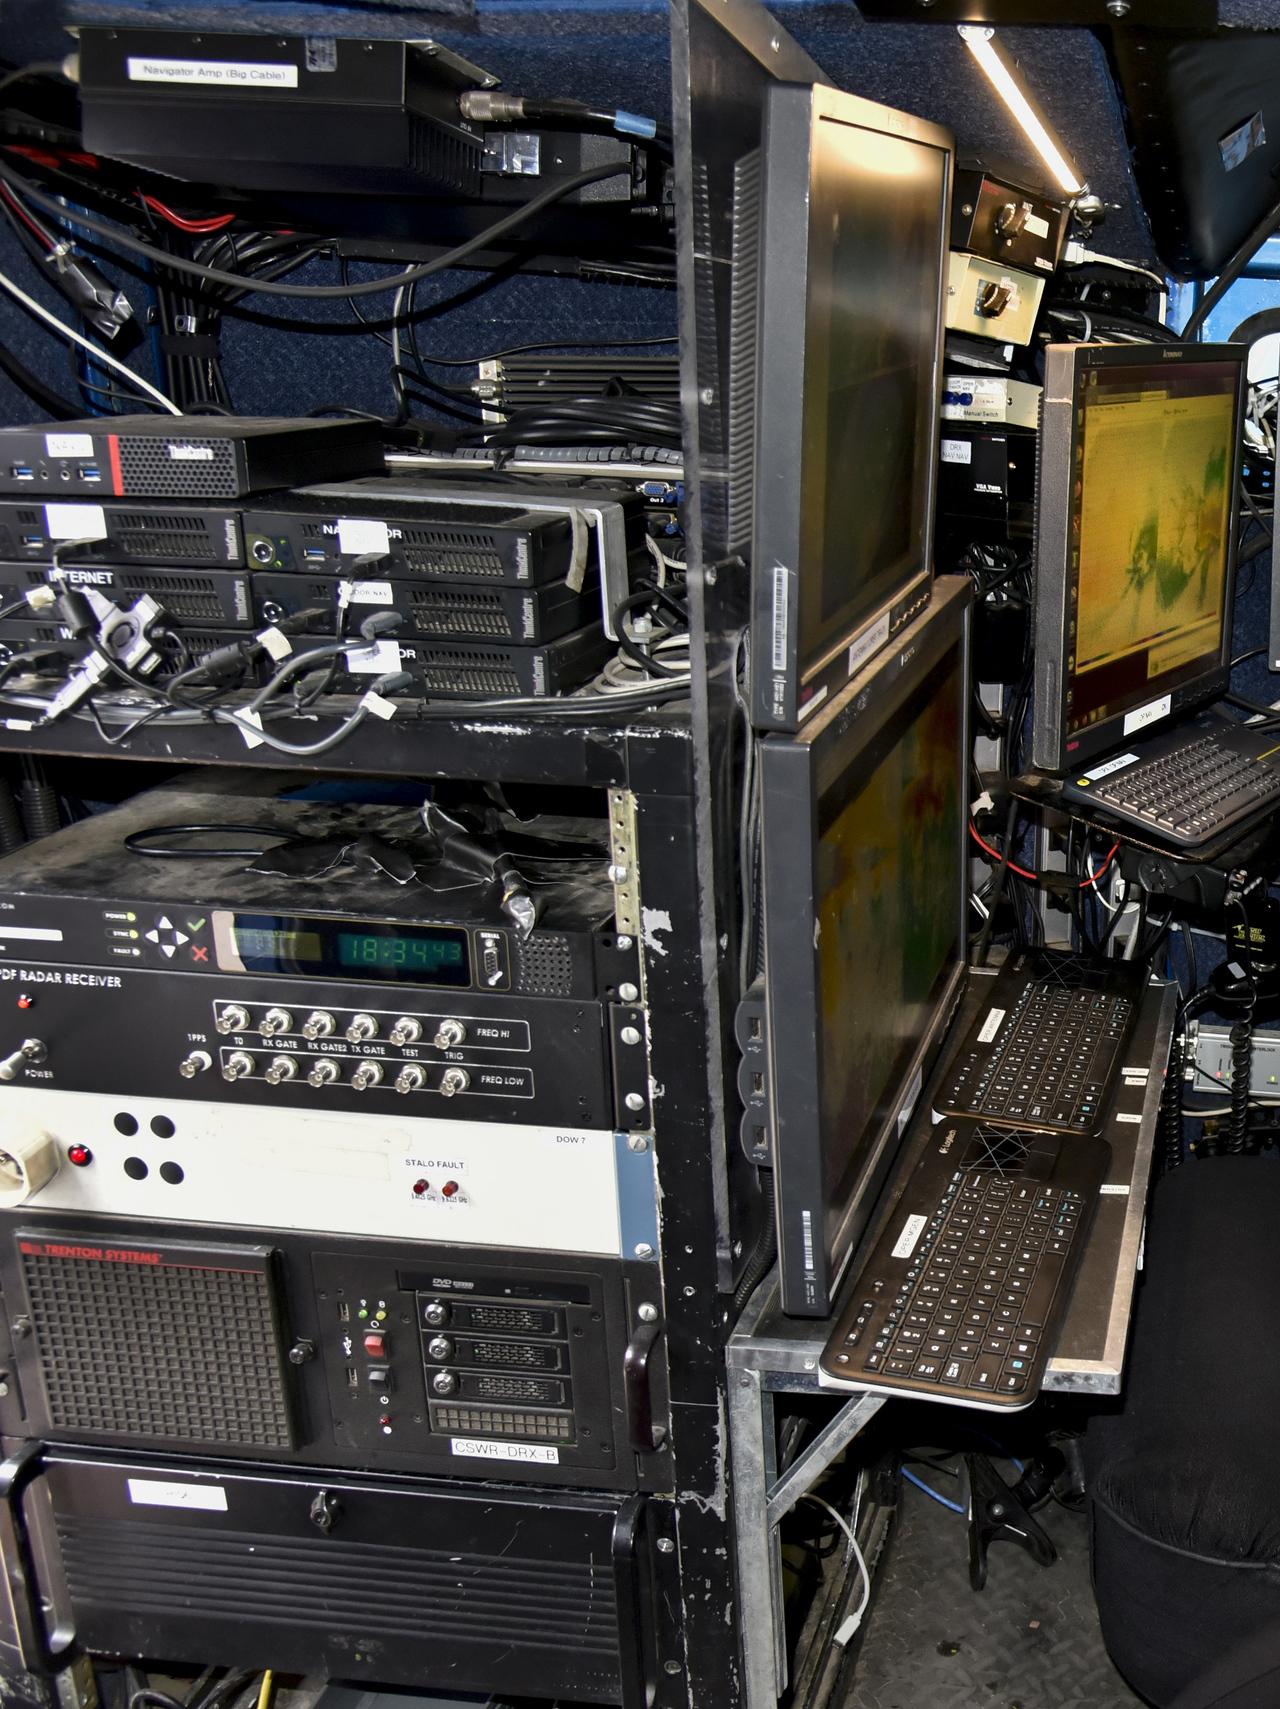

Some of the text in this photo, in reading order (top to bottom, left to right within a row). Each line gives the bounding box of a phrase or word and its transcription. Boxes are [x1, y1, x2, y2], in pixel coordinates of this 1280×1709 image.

[143, 64, 286, 81] Navigator Amp (Big Cable)
[224, 519, 239, 561] ThinkCentre
[516, 538, 528, 579] ThinkCentre
[234, 580, 249, 621] ThinkCentre
[523, 598, 534, 639] ThinkCentre
[533, 656, 545, 696] ThinkCentre
[352, 938, 427, 964] 18:34
[20, 970, 62, 984] RADAR
[65, 972, 122, 988] RECEIVER
[187, 1033, 207, 1043] 1PPS
[477, 1028, 510, 1038] FREQ HI
[262, 1039, 298, 1049] RX GATE
[307, 1042, 347, 1052] RX GATE2
[351, 1045, 386, 1055] TX GATE
[401, 1049, 419, 1057] TEST
[444, 1052, 464, 1060] TRIG
[25, 1069, 54, 1079] POWER
[481, 1075, 524, 1086] FREQ LOW
[556, 1135, 579, 1144] DOW
[405, 1158, 464, 1169] STALO FAULT
[44, 1244, 159, 1264] TRENTON SYSTEMS
[455, 1441, 556, 1461] CSWR-DRX-B
